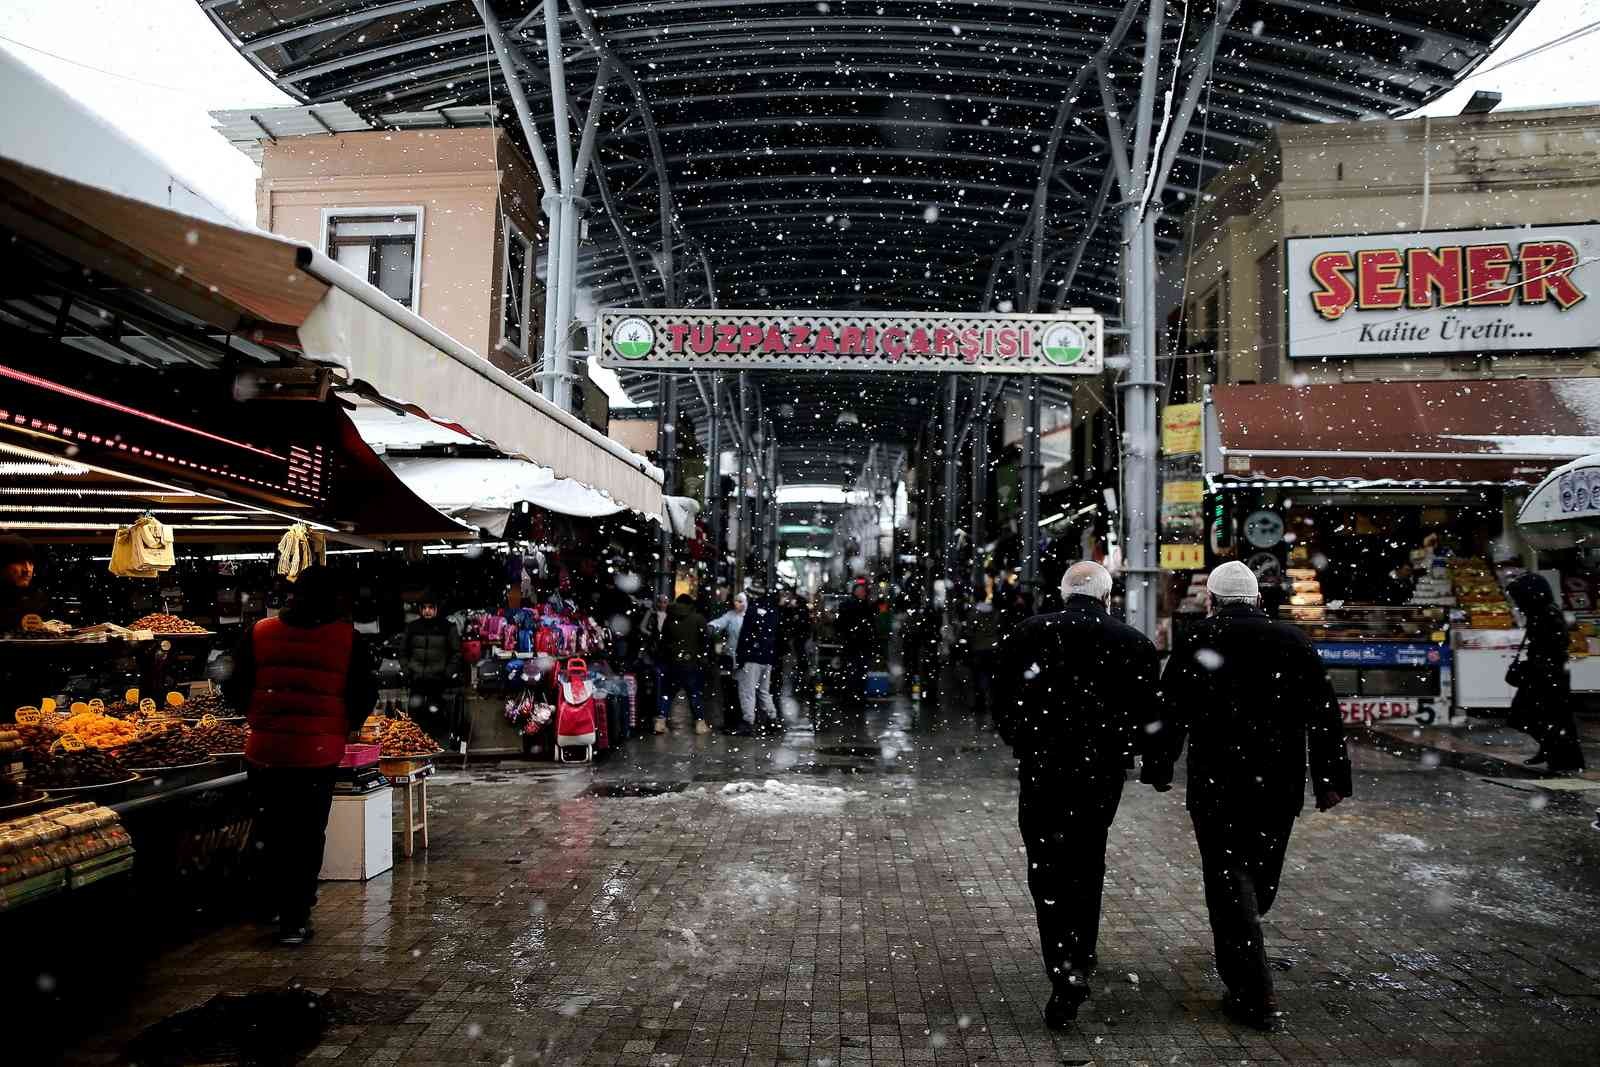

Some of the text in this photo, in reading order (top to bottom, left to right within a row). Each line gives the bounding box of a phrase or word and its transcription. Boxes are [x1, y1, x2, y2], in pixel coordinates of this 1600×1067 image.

[668, 324, 876, 354] TUZPAZARI
[882, 327, 1033, 364] ÇARŞISI
[1359, 321, 1430, 343] Kalite
[1414, 697, 1436, 724] 5
